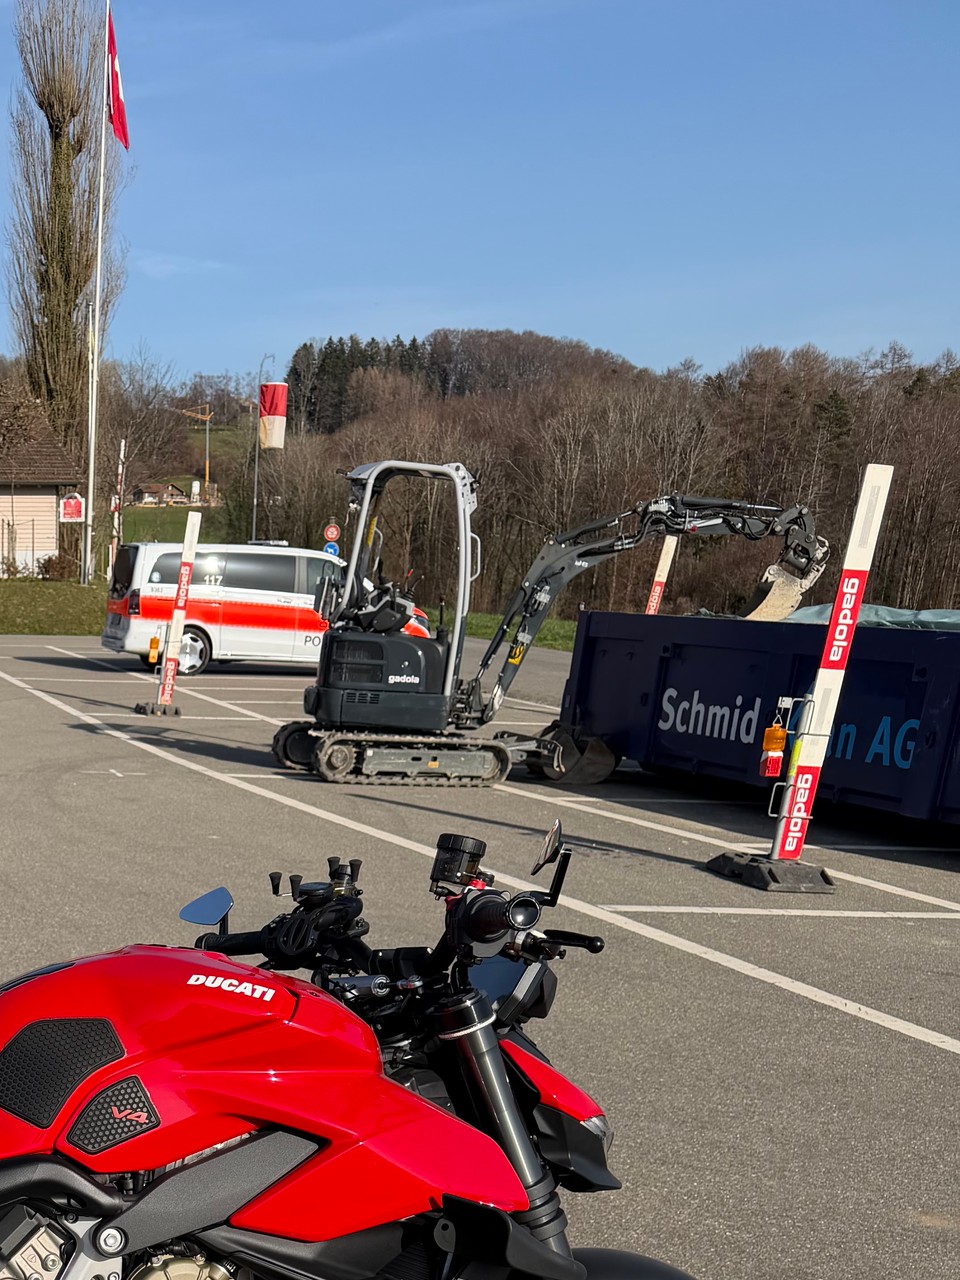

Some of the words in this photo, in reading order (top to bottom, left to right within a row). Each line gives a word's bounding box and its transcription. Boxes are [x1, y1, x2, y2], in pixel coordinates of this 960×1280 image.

[177, 565, 191, 607] gadola
[203, 575, 224, 586] 117
[829, 577, 860, 662] gadola
[388, 674, 420, 684] gadola
[657, 687, 762, 745] Schmid
[864, 715, 921, 769] AG
[784, 773, 813, 851] gadola
[186, 974, 276, 1002] DUCATI
[111, 1106, 149, 1124] V4
